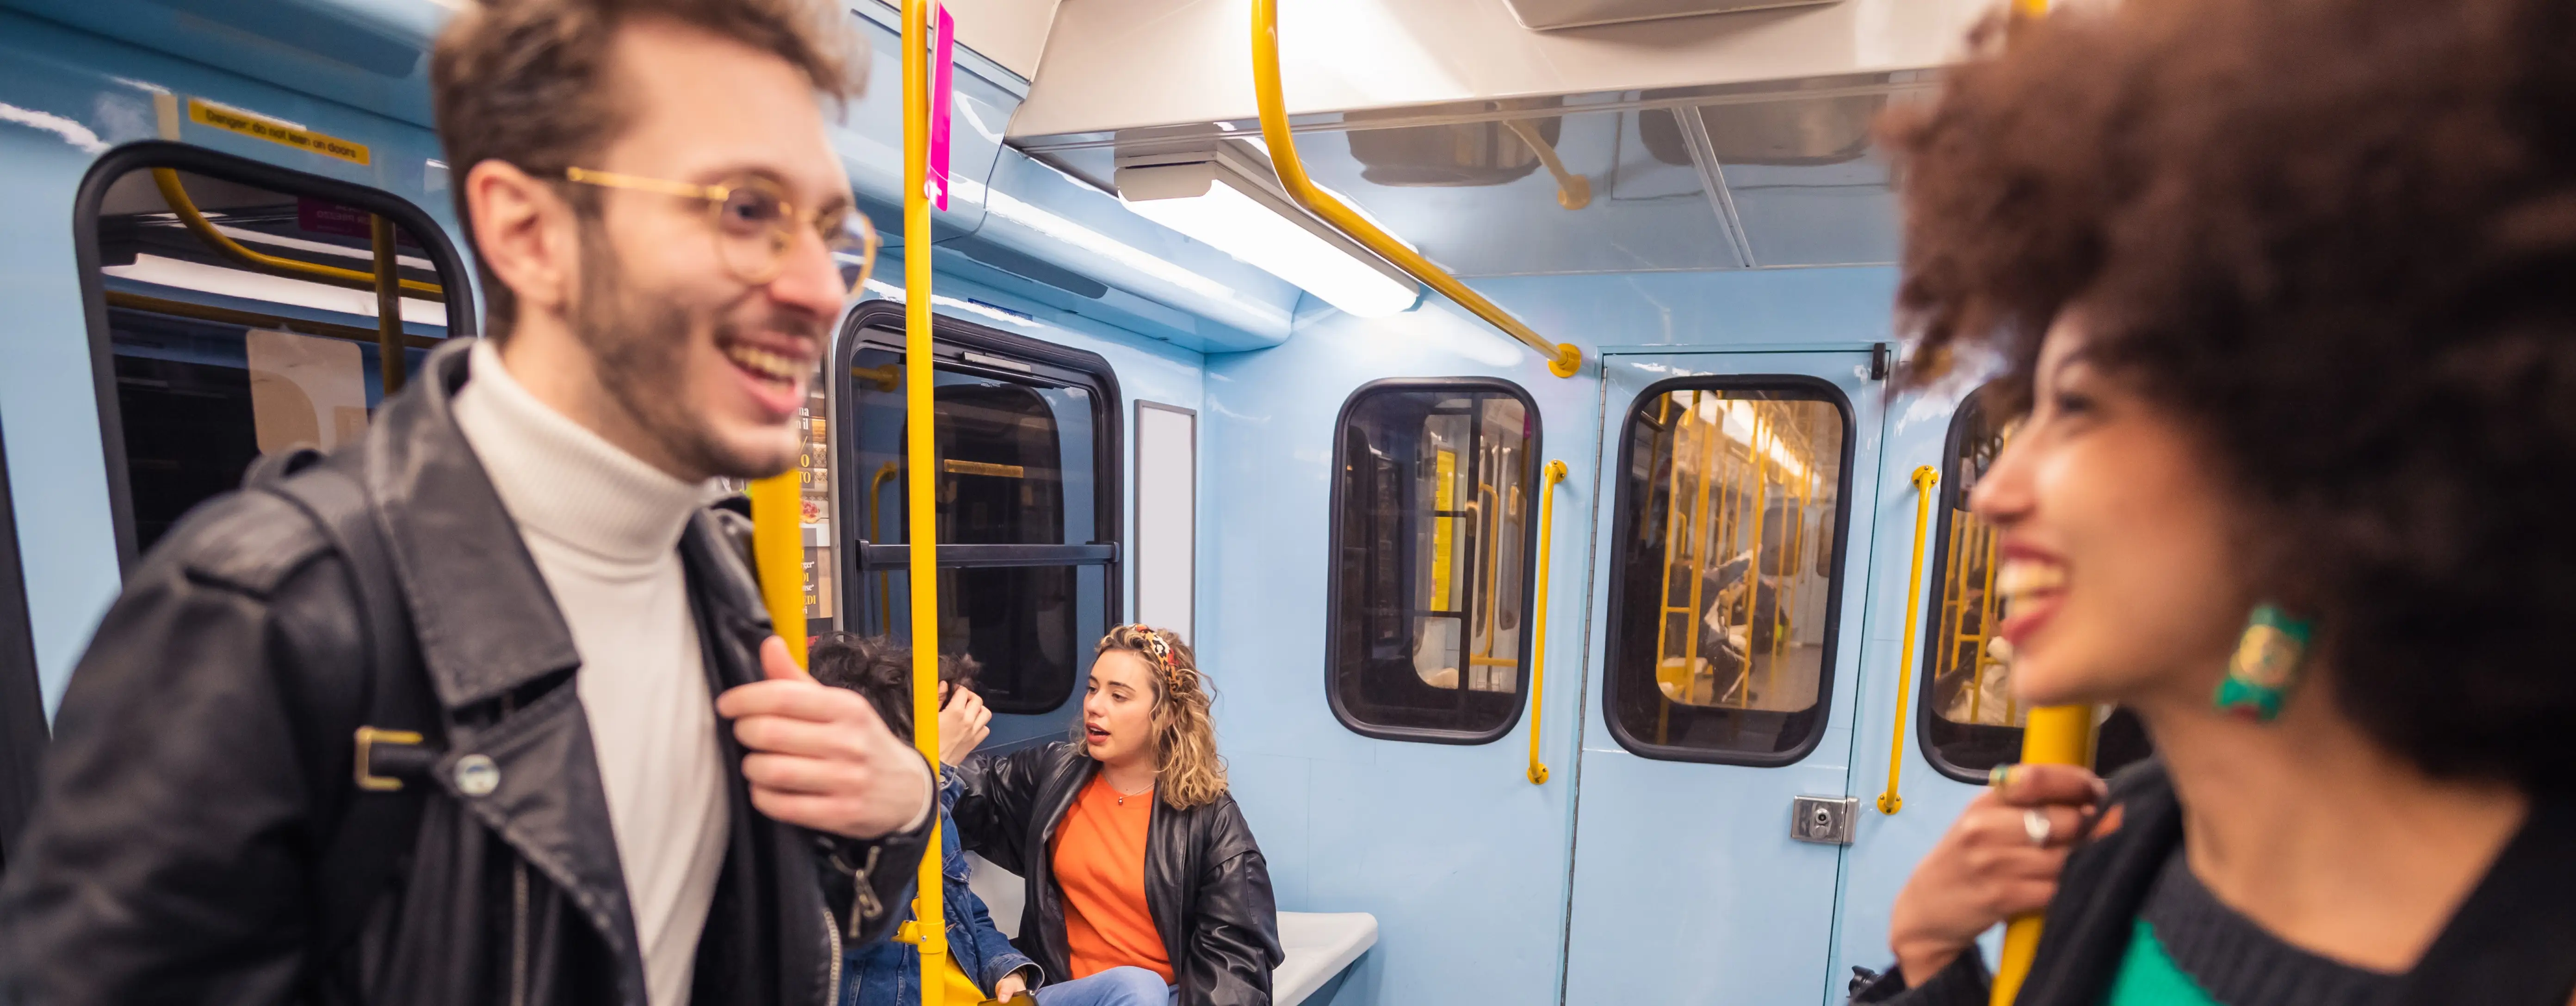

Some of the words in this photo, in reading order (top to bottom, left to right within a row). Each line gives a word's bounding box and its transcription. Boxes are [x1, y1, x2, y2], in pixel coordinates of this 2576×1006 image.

[252, 122, 266, 135] do
[268, 128, 286, 139] not
[288, 131, 311, 146] lean
[312, 140, 326, 151] on
[328, 142, 357, 158] doors
